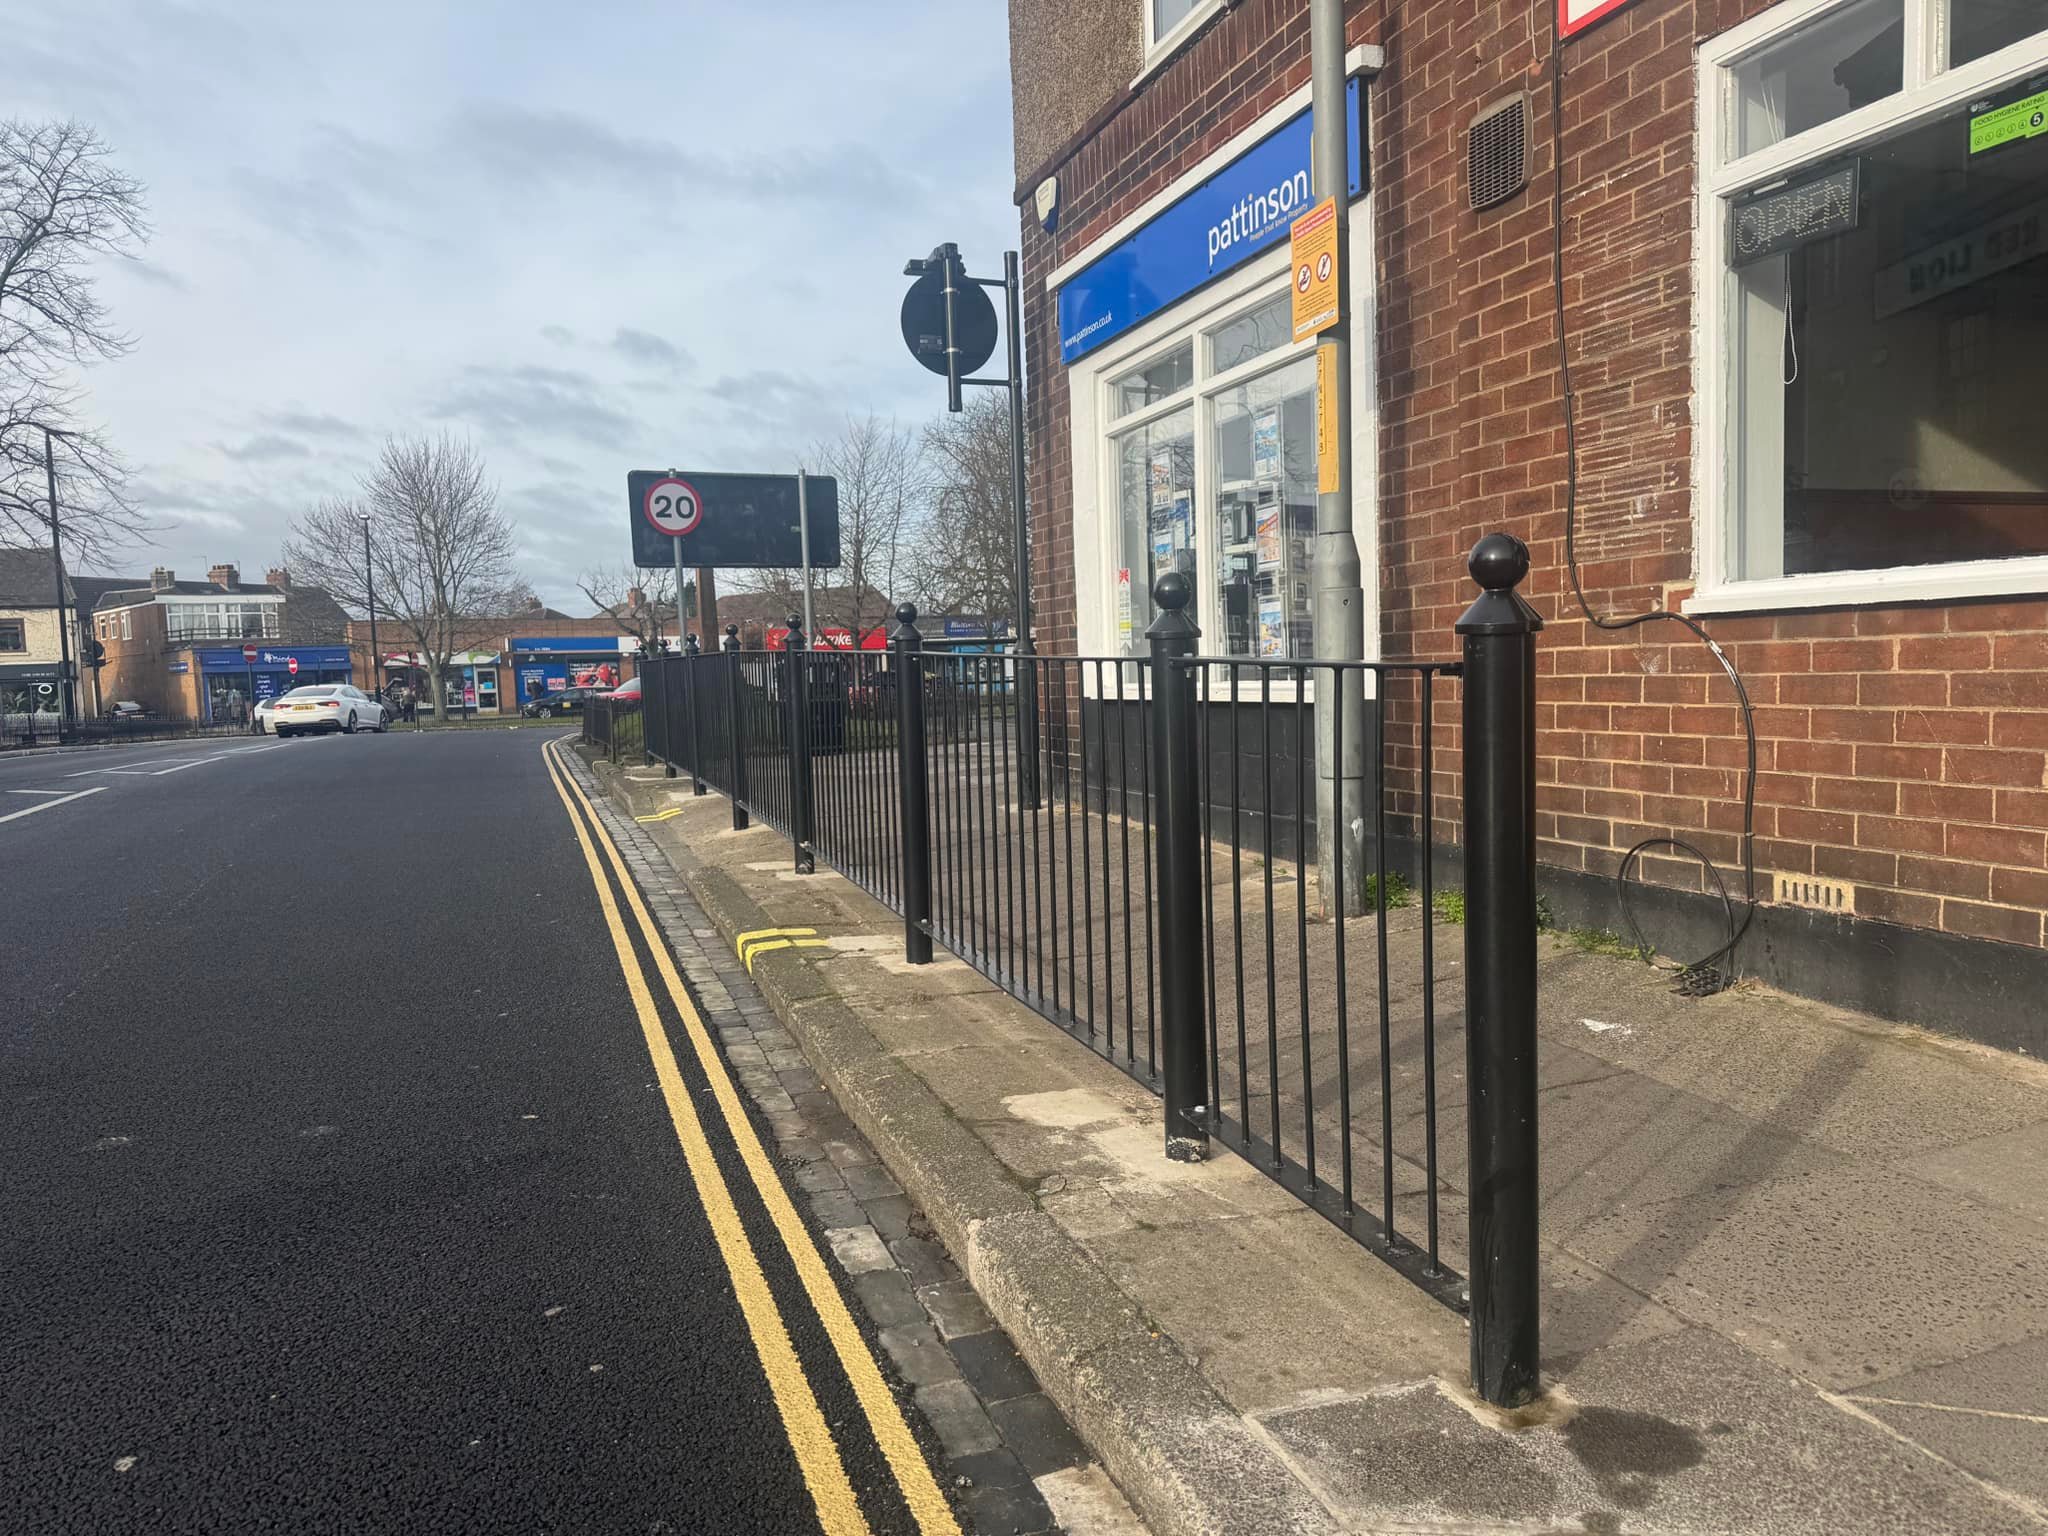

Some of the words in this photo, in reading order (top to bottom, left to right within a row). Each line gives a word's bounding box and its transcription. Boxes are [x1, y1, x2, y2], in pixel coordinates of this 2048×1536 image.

[1974, 114, 1993, 127] FOOD
[1993, 105, 2020, 120] HYGIENE
[2021, 95, 2046, 109] RATING
[2033, 113, 2041, 125] 5
[1208, 169, 1308, 266] pattinson
[1736, 171, 1851, 254] OPEN
[1064, 309, 1113, 348] www.pattinson.co.uk
[654, 494, 696, 520] 20
